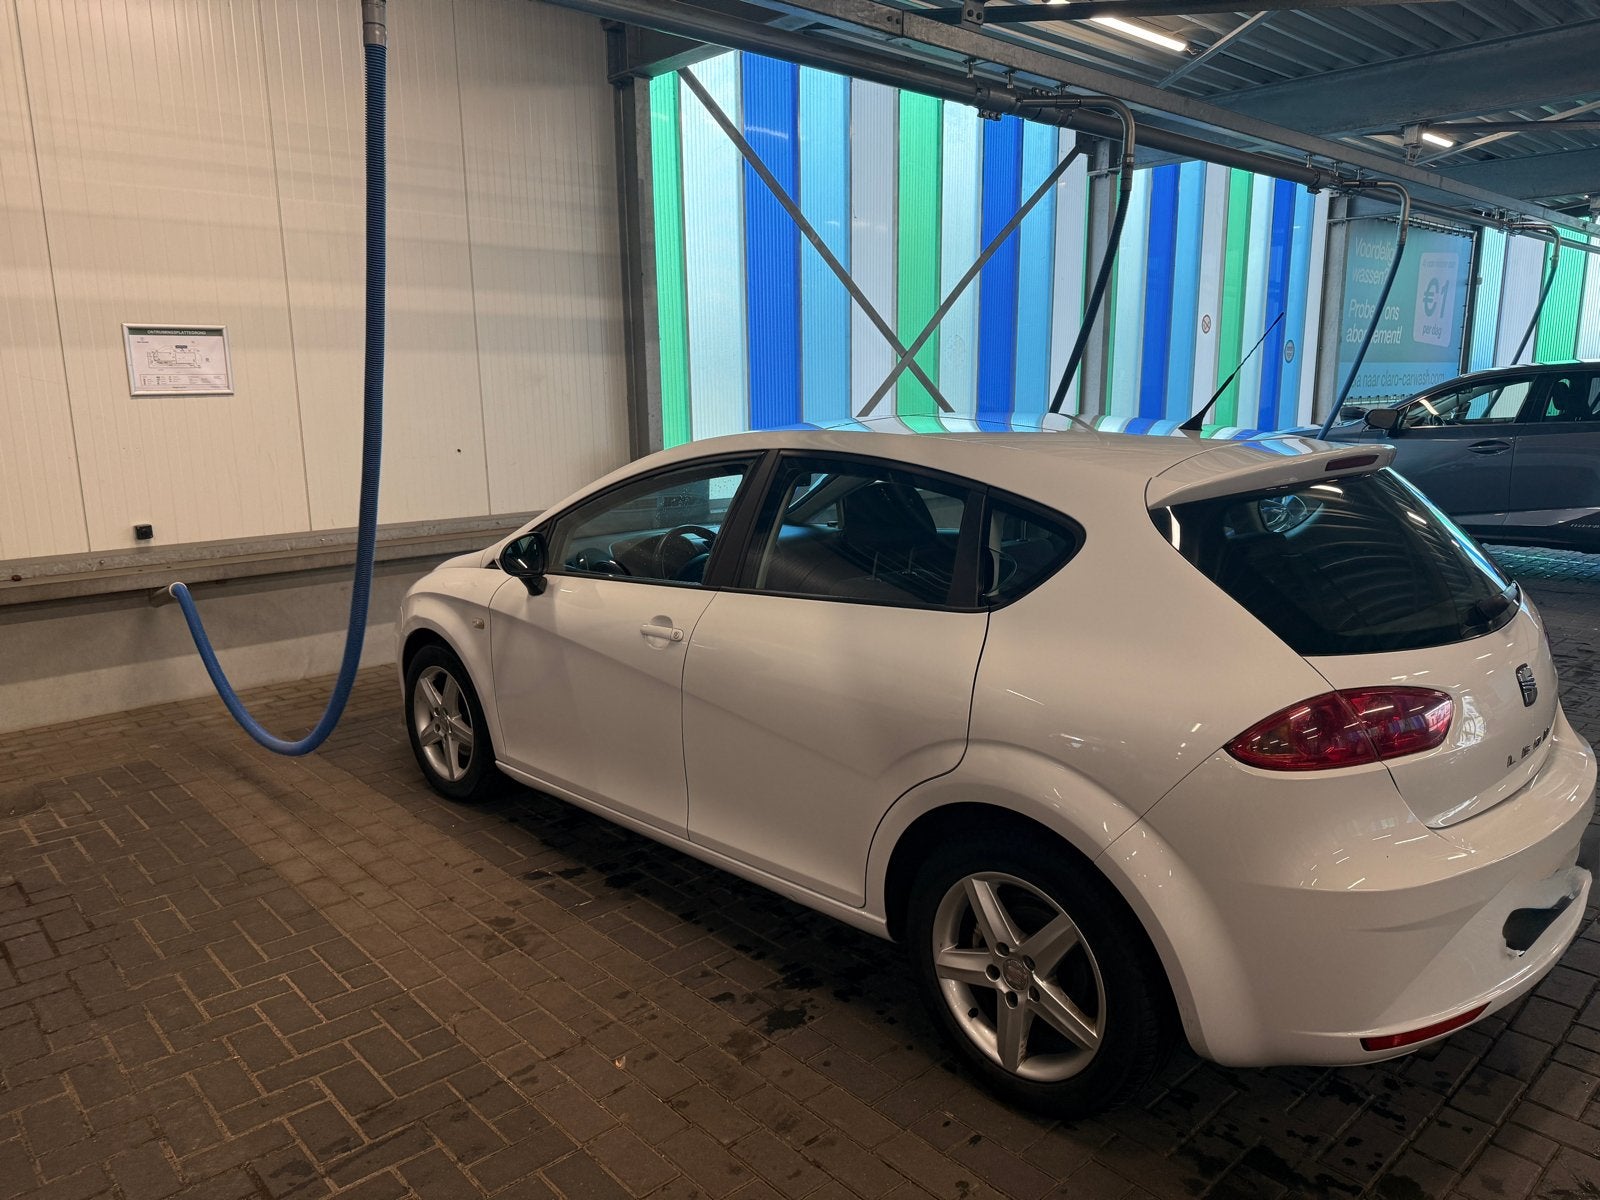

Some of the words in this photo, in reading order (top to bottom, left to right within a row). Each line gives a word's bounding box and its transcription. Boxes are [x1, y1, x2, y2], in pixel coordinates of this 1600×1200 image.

[1355, 237, 1395, 267] Voordelig
[1423, 277, 1450, 319] €1
[1384, 306, 1400, 321] ons
